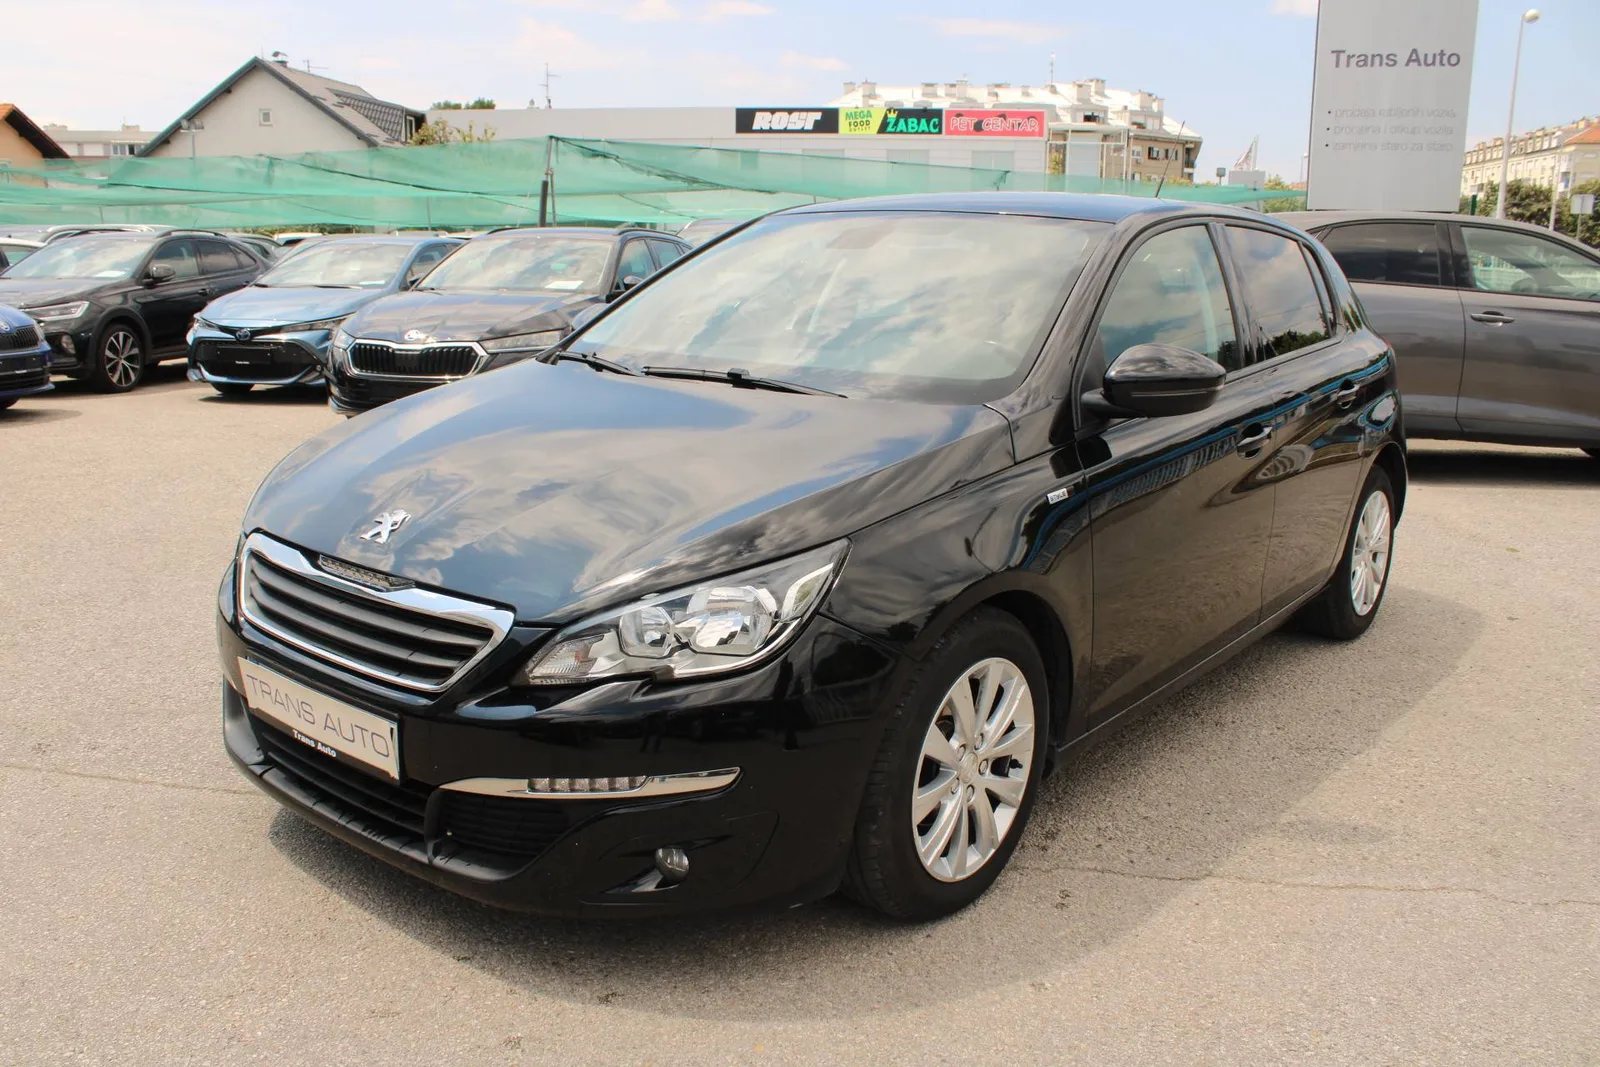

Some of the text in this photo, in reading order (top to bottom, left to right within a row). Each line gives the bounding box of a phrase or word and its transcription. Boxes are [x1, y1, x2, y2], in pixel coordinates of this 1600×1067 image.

[1331, 48, 1461, 68] Trans Auto
[752, 111, 822, 130] ROST
[845, 110, 872, 120] MEGA
[1334, 107, 1375, 120] prodaja
[950, 117, 1039, 132] PET CENTAR
[1381, 141, 1408, 151] staro
[1411, 142, 1424, 151] za
[1426, 141, 1453, 151] staro
[247, 674, 389, 757] TRANS AUTO
[293, 729, 337, 757] Trans Auto
